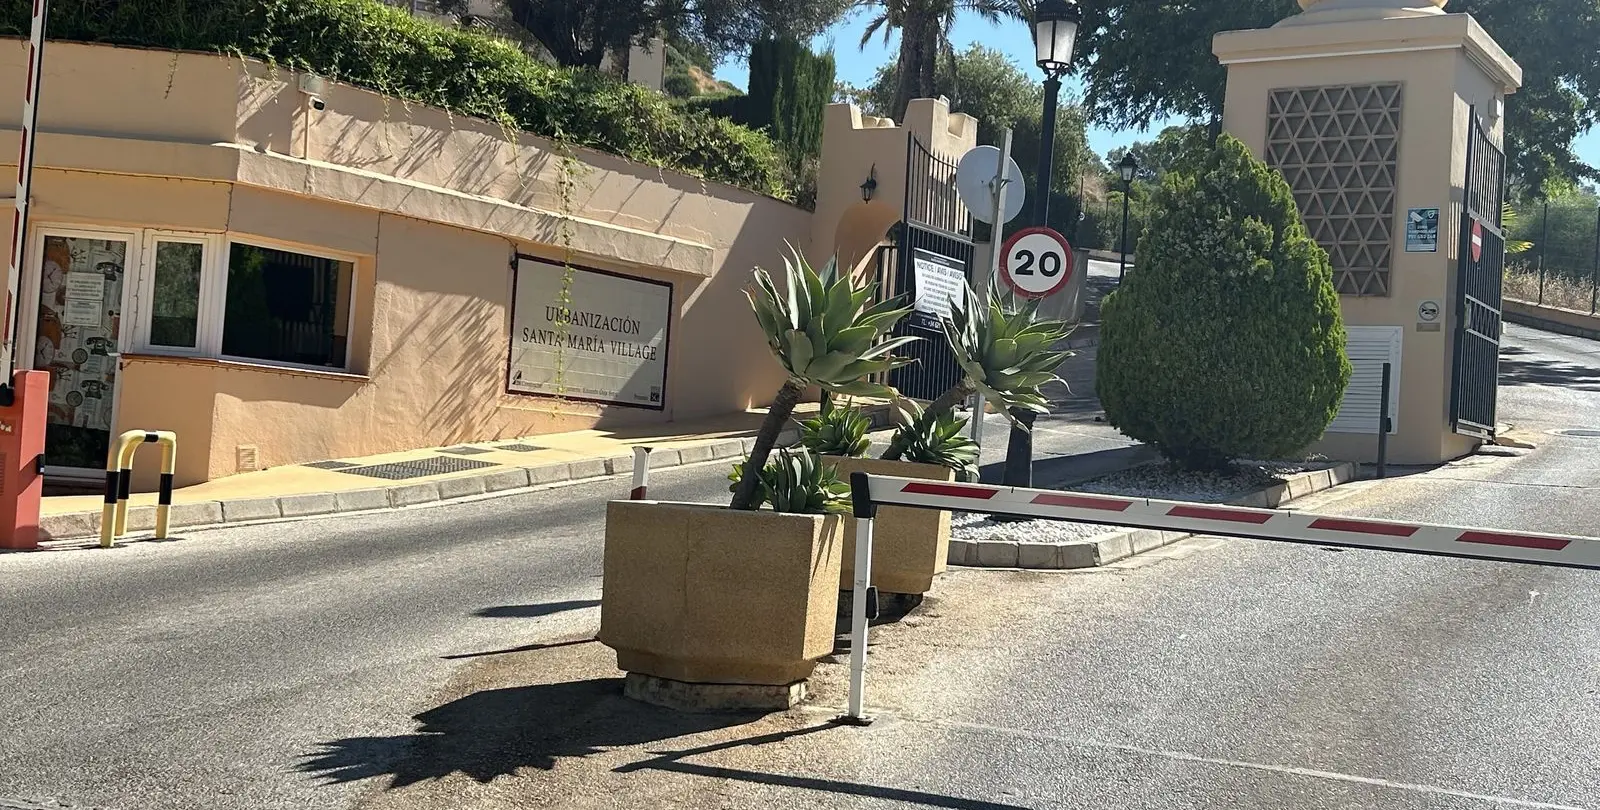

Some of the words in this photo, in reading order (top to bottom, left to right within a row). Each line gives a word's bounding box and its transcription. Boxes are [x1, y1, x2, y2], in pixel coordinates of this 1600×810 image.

[917, 261, 934, 273] NOTICE
[937, 266, 947, 276] AVIS
[949, 270, 963, 281] AVISO
[1015, 249, 1061, 277] 20
[545, 305, 641, 335] URBANIZACIÓN
[522, 327, 562, 347] SANTA
[567, 333, 605, 354] MARÍA
[610, 340, 657, 361] VILLAGE
